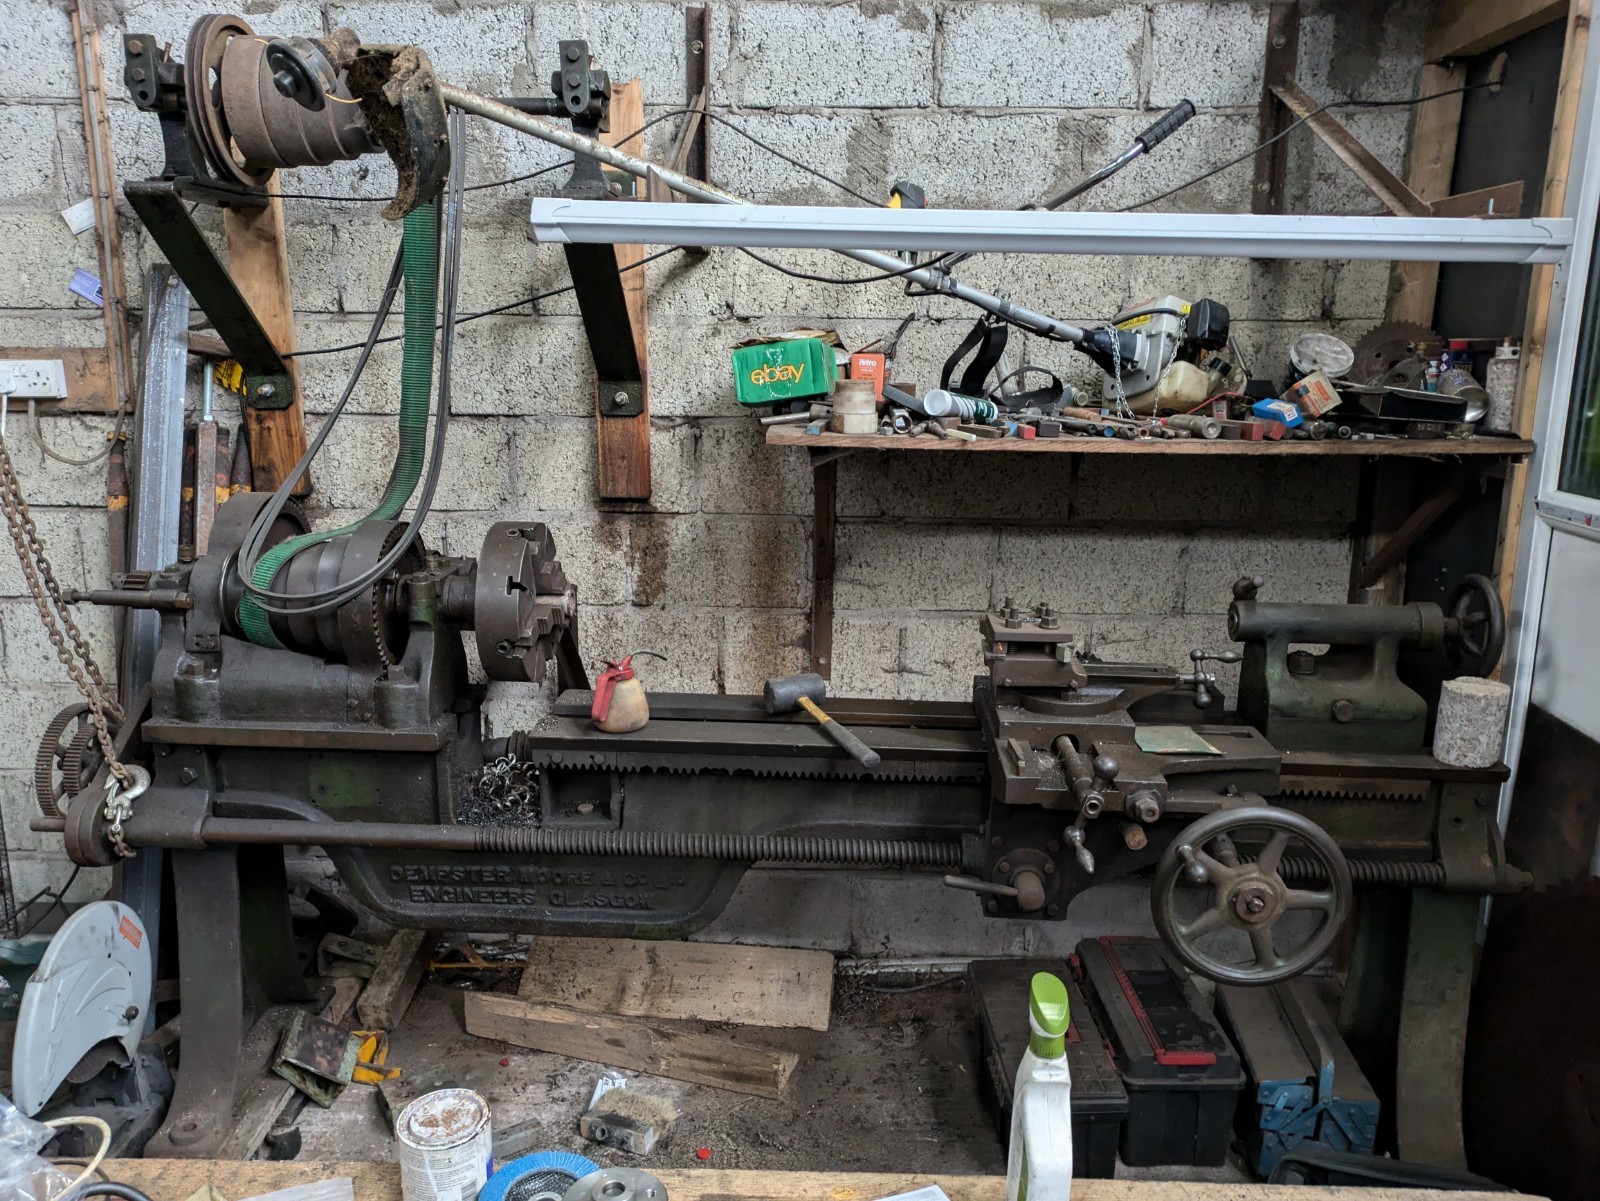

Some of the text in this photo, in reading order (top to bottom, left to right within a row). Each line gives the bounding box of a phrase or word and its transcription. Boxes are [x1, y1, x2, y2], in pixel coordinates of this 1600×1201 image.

[750, 362, 804, 384] ebay
[389, 864, 512, 885] DEMPSTER
[519, 865, 595, 886] MOORE
[409, 884, 657, 909] ENGINEERS GLASGOW
